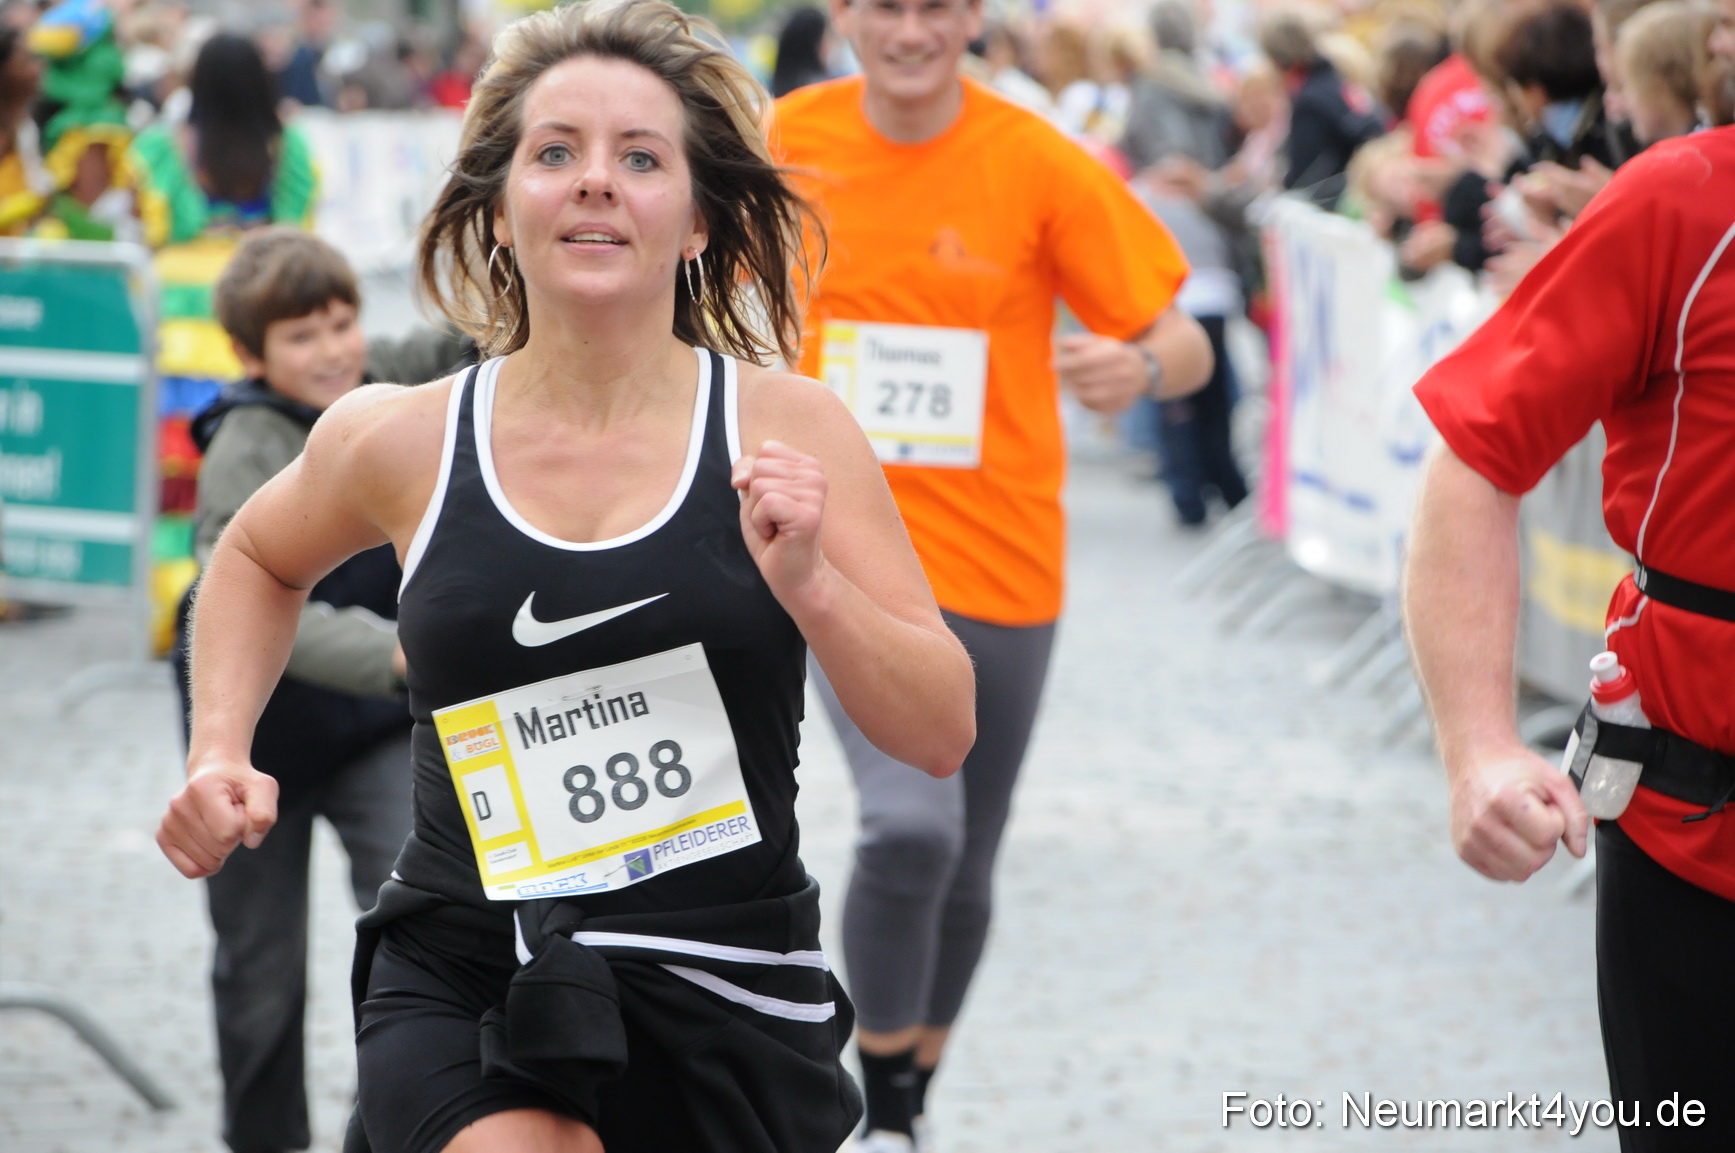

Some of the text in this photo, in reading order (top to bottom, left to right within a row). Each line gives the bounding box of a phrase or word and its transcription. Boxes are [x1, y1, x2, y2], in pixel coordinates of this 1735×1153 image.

[877, 380, 952, 419] 278
[513, 691, 650, 749] Martina
[563, 739, 692, 824] 888
[472, 791, 492, 821] D
[652, 816, 751, 860] PFLEIDERER
[517, 872, 588, 896] BOCK
